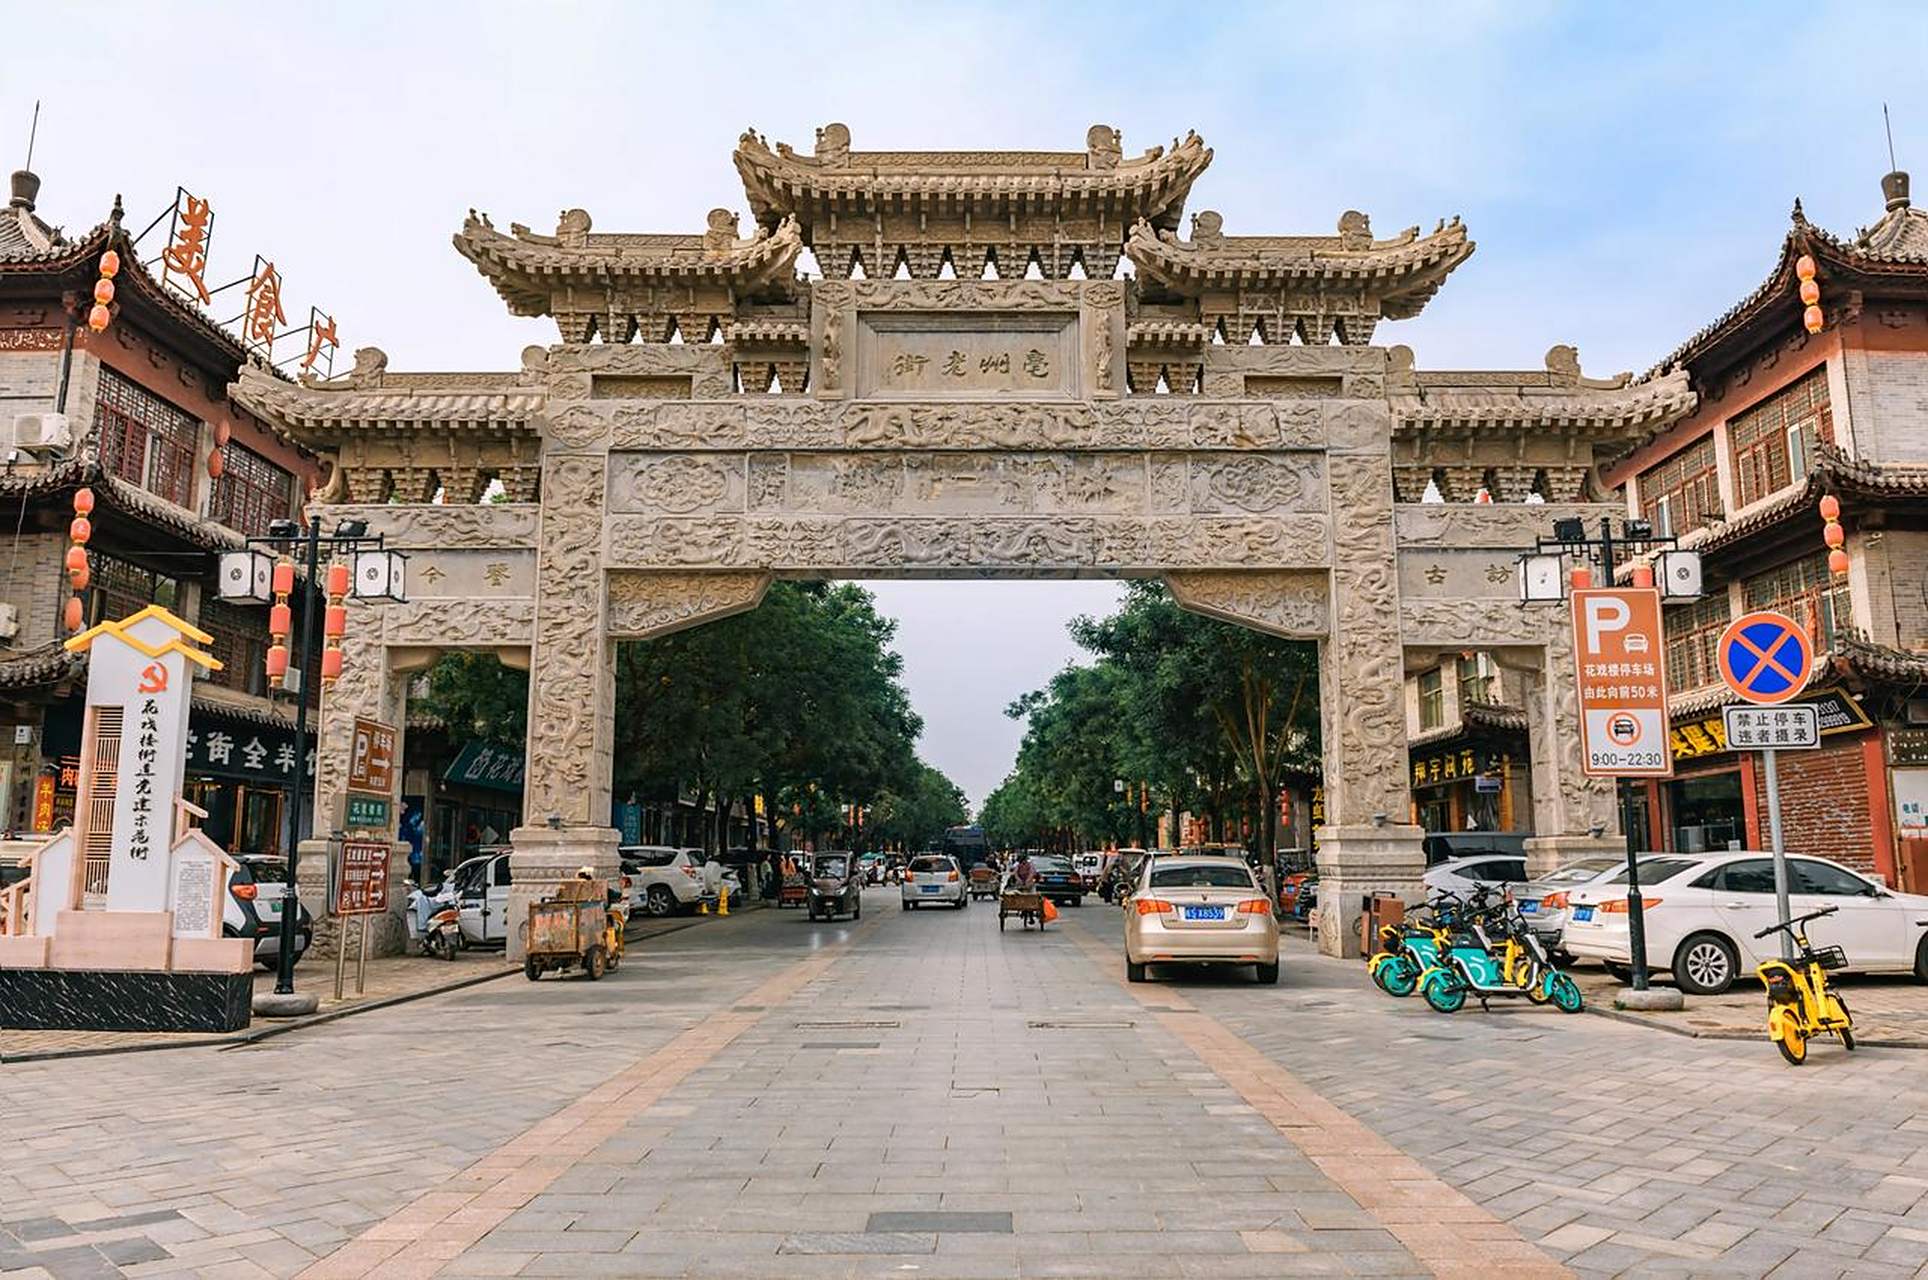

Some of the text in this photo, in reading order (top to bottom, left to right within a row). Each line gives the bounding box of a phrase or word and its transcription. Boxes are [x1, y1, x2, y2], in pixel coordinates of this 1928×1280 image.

[1585, 597, 1631, 654] P
[1584, 664, 1655, 677] 花戏楼停车场
[1584, 686, 1659, 699] 由此向前50米
[1737, 712, 1807, 727] 禁止停车
[1738, 728, 1808, 743] 违者摄录
[1592, 753, 1662, 766] 9:00-22:30
